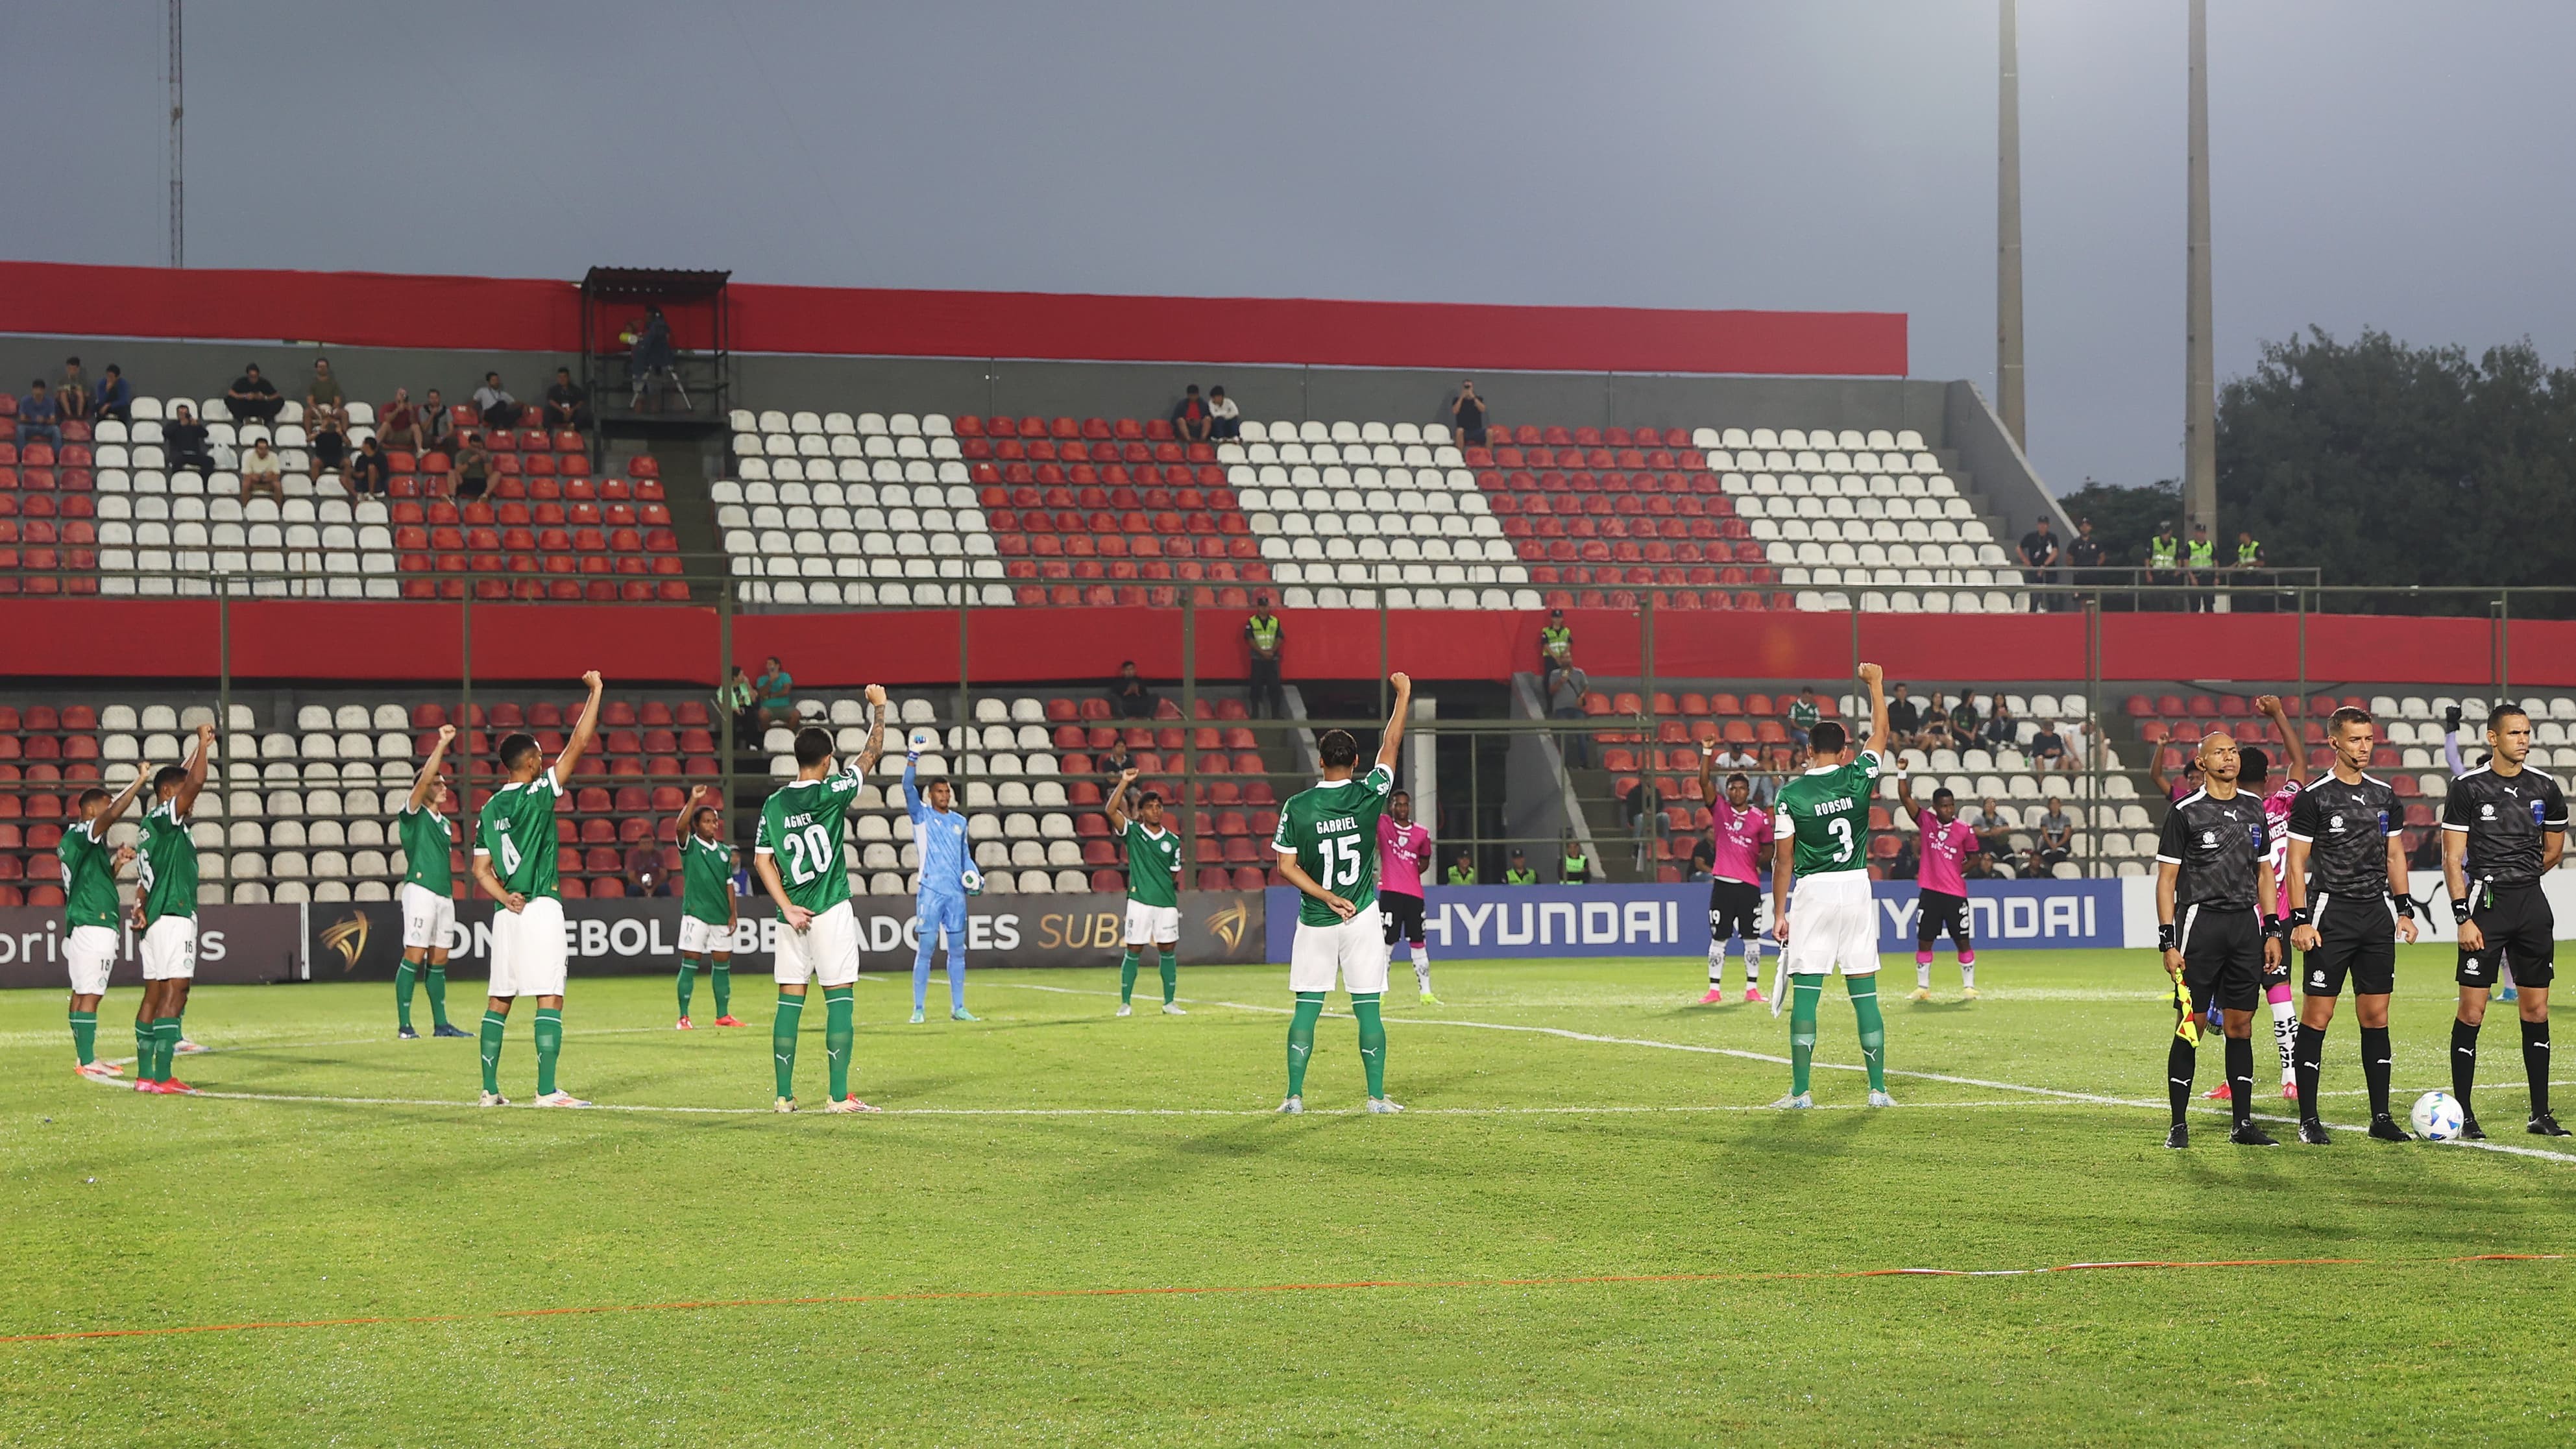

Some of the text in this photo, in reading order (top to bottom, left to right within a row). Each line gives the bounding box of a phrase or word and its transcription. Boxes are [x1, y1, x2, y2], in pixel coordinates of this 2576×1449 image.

[1814, 797, 1853, 816] ROBSON
[784, 812, 813, 829] AGNER
[1316, 816, 1358, 834] GABRIEL
[1828, 817, 1854, 863] 3
[783, 824, 833, 884] 20
[1318, 833, 1361, 890] 15
[414, 917, 423, 928] 13
[1425, 901, 1679, 946] HYUNDAI
[1709, 910, 1720, 924] 19
[1873, 895, 2096, 940] YNDAI
[425, 918, 675, 960] ONEBOL
[1038, 913, 1150, 949] SUB
[185, 940, 193, 953] 16
[101, 959, 110, 971] 18
